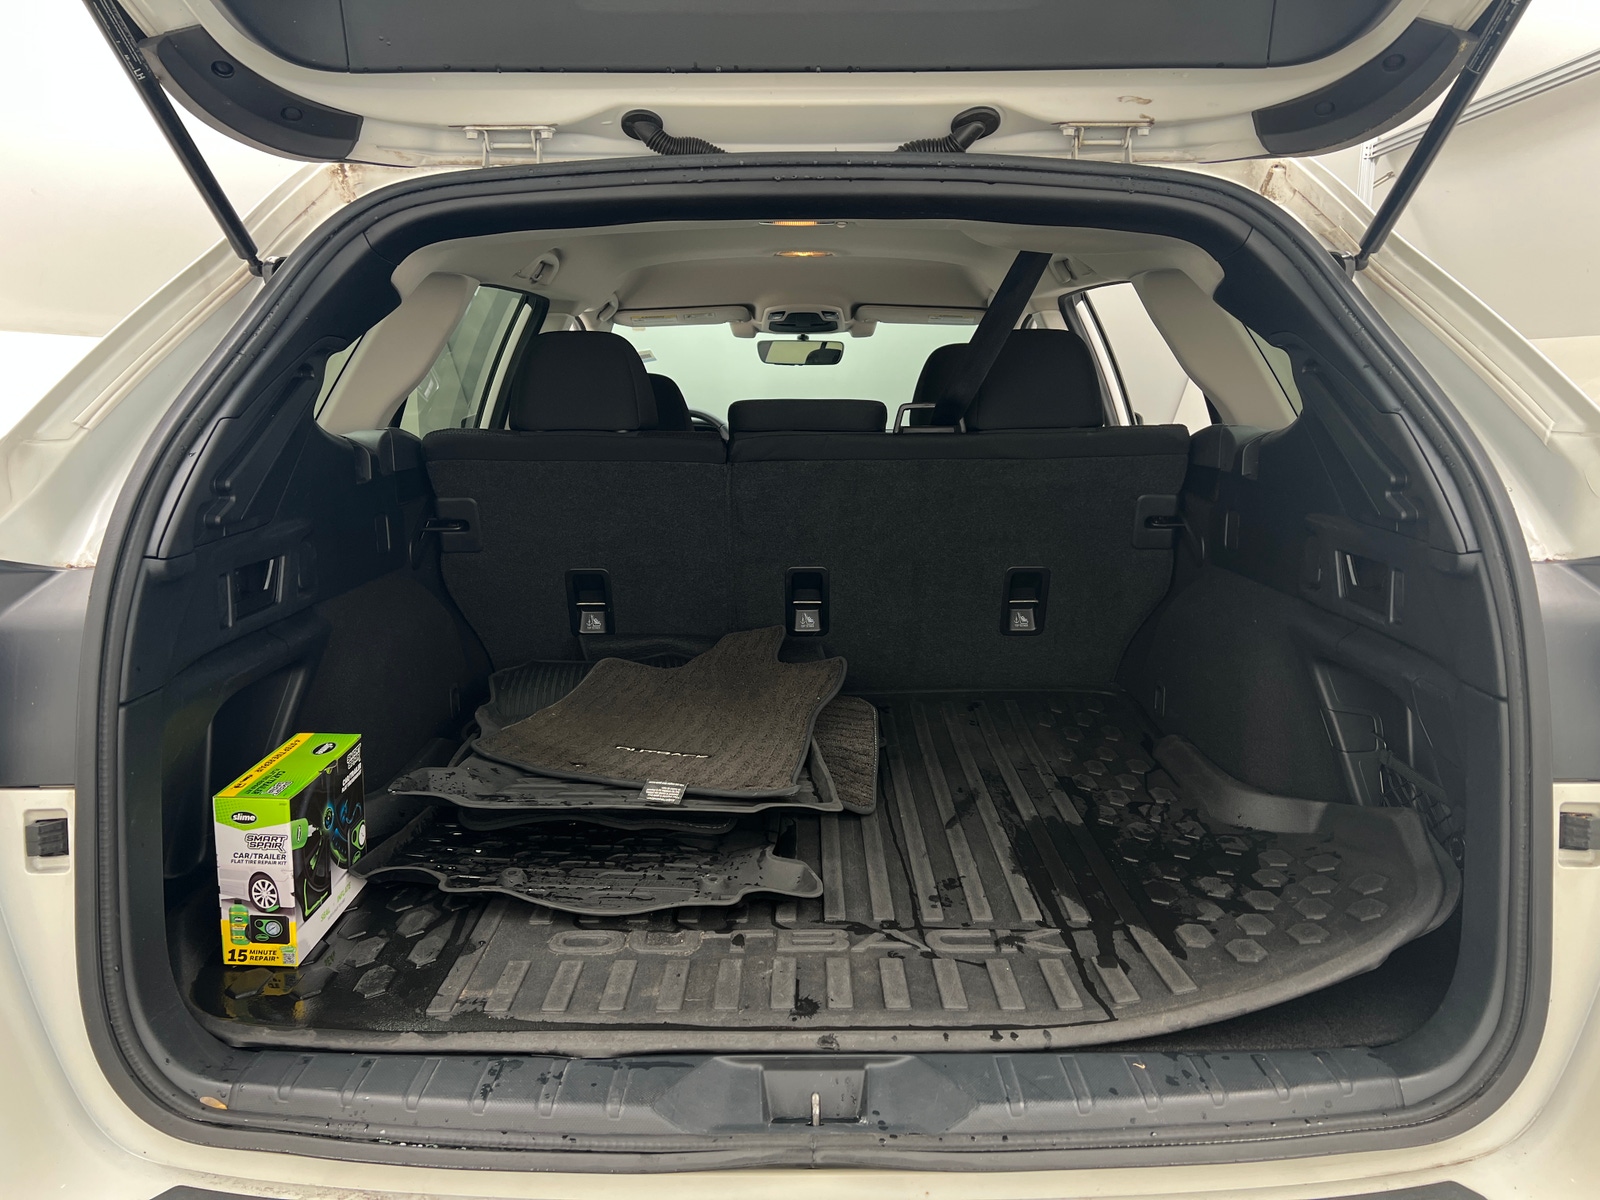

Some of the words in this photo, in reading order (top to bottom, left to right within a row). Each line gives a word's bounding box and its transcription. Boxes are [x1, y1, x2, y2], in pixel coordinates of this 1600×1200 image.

[134, 68, 146, 81] LH
[232, 813, 256, 822] slime
[246, 834, 287, 842] SMART
[249, 842, 284, 851] SPAIR
[233, 852, 287, 860] CAR/TRAILER
[227, 949, 248, 962] 15
